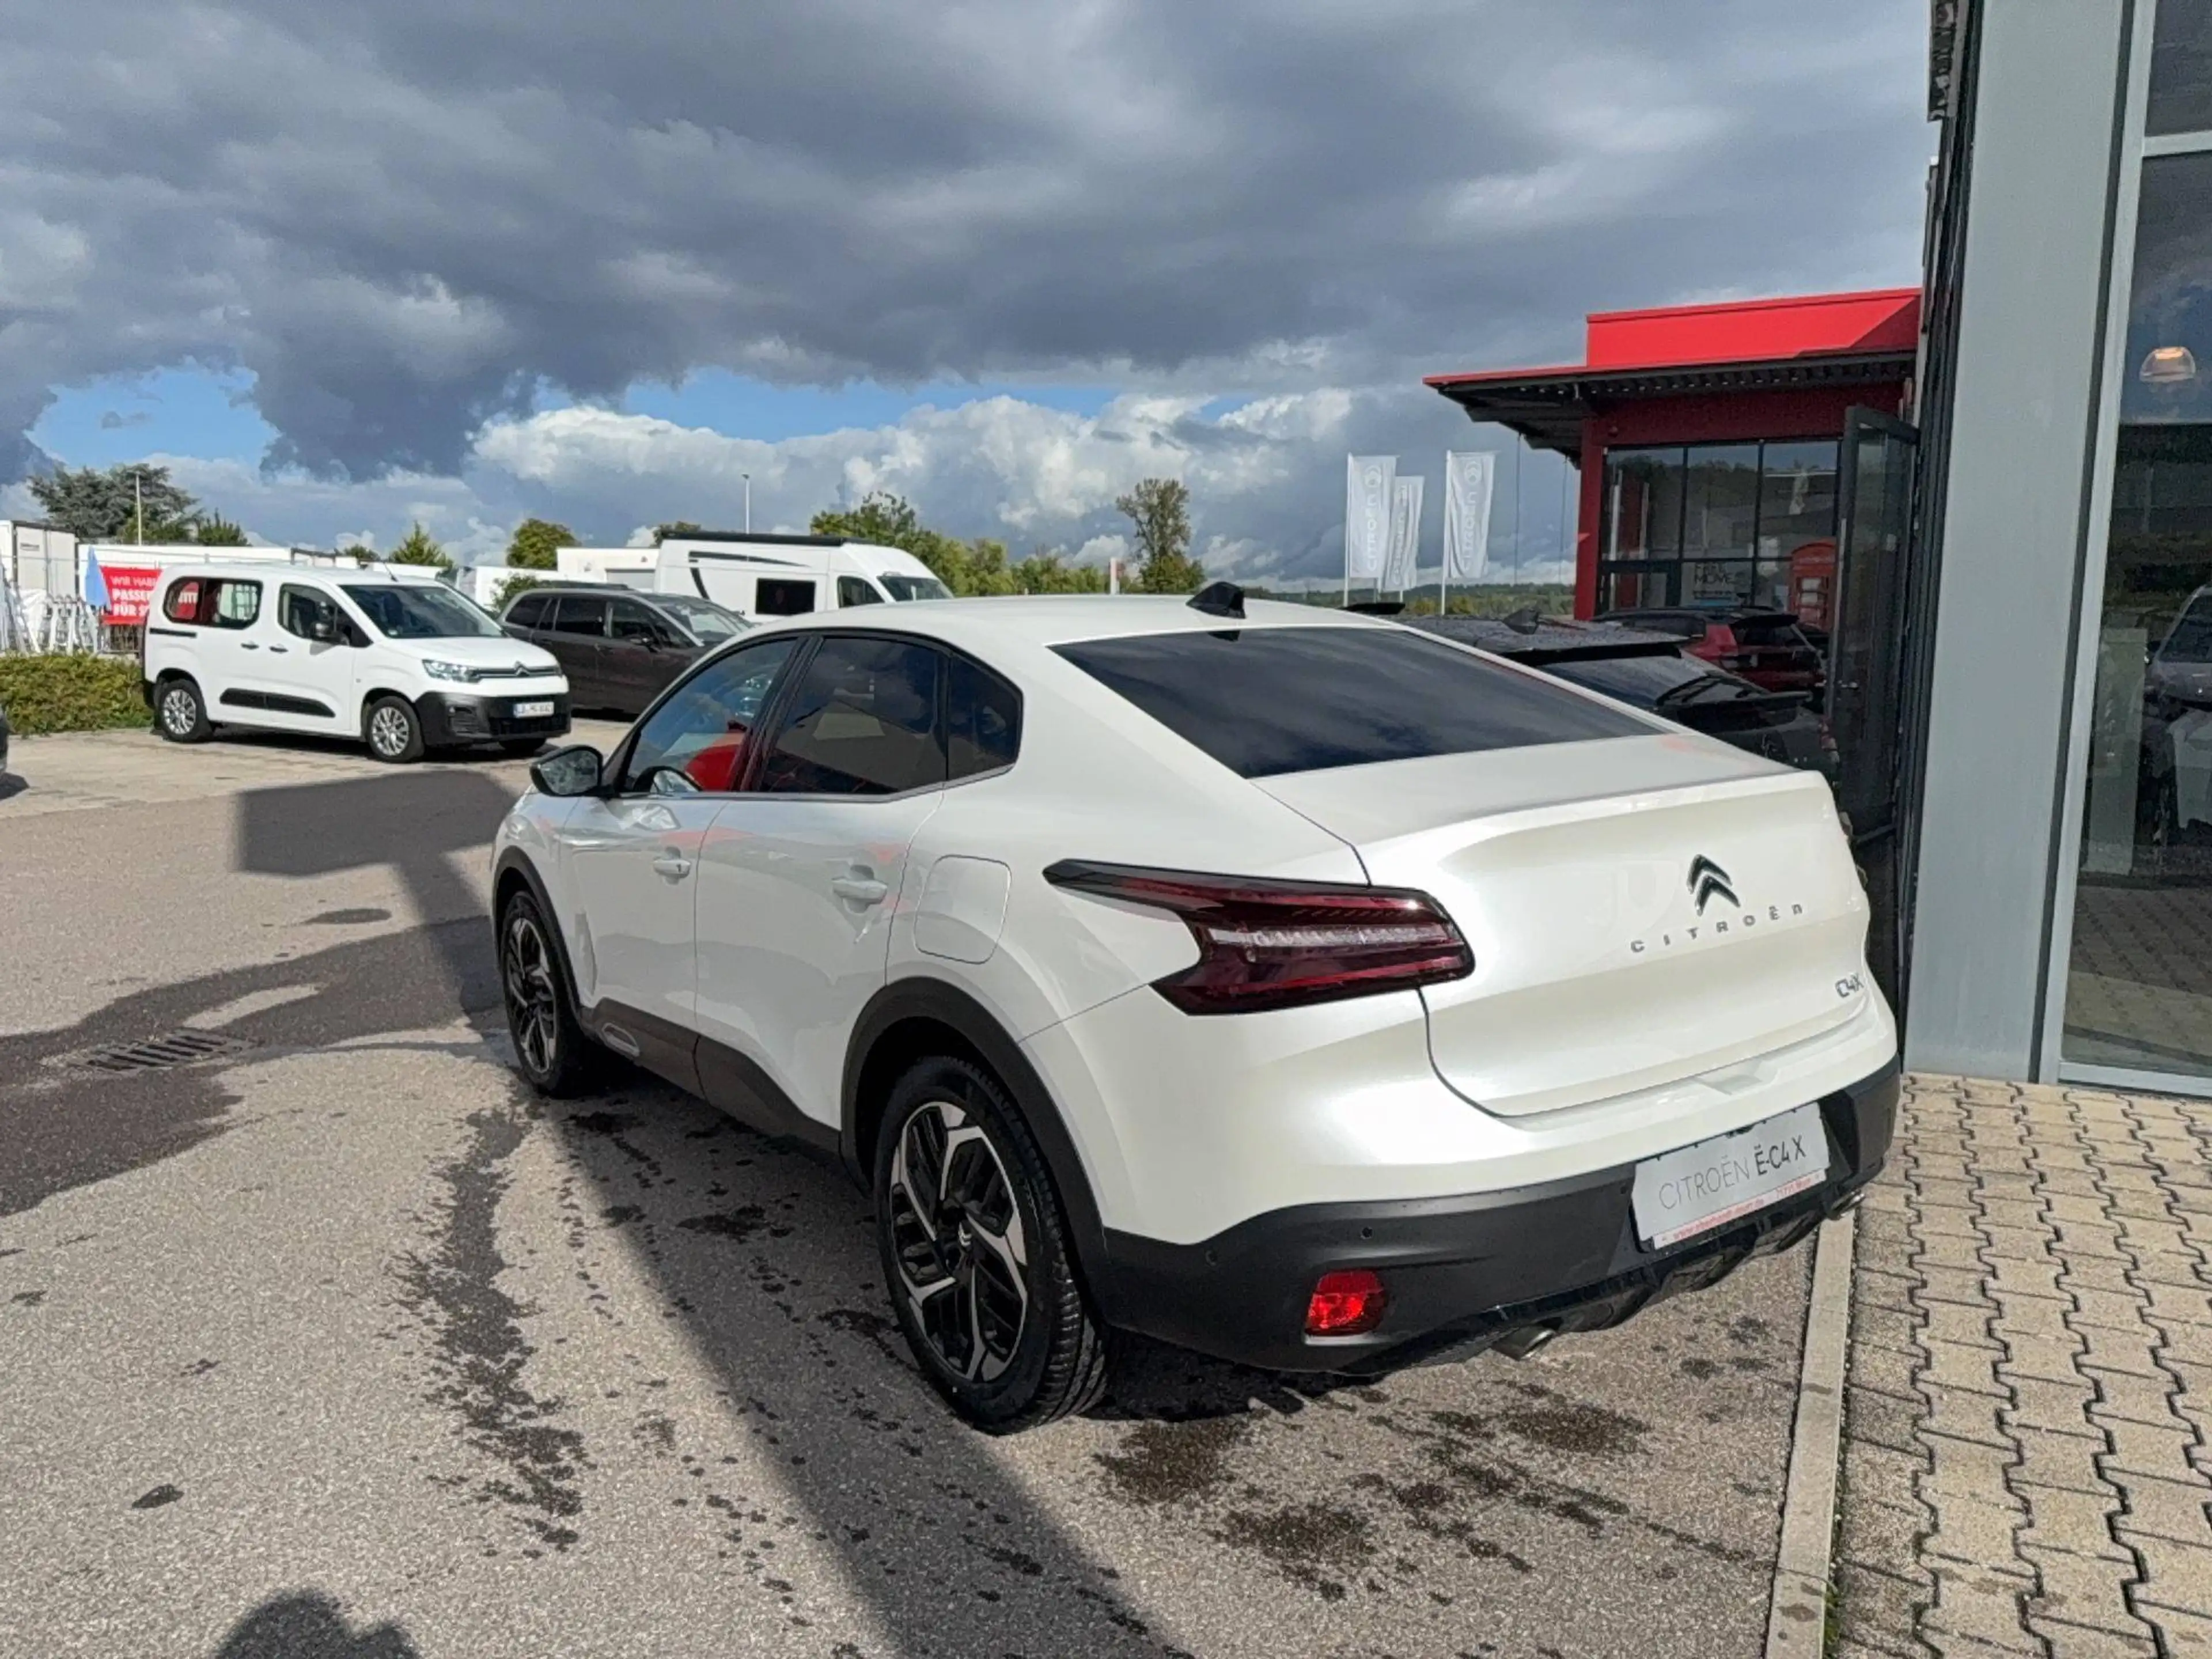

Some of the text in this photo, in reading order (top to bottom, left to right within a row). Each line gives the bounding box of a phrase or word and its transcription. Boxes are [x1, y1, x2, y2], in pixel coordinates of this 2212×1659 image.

[113, 602, 137, 616] FÜR
[1630, 903, 1802, 953] CITROËN
[1659, 1155, 1749, 1209] CITROËN
